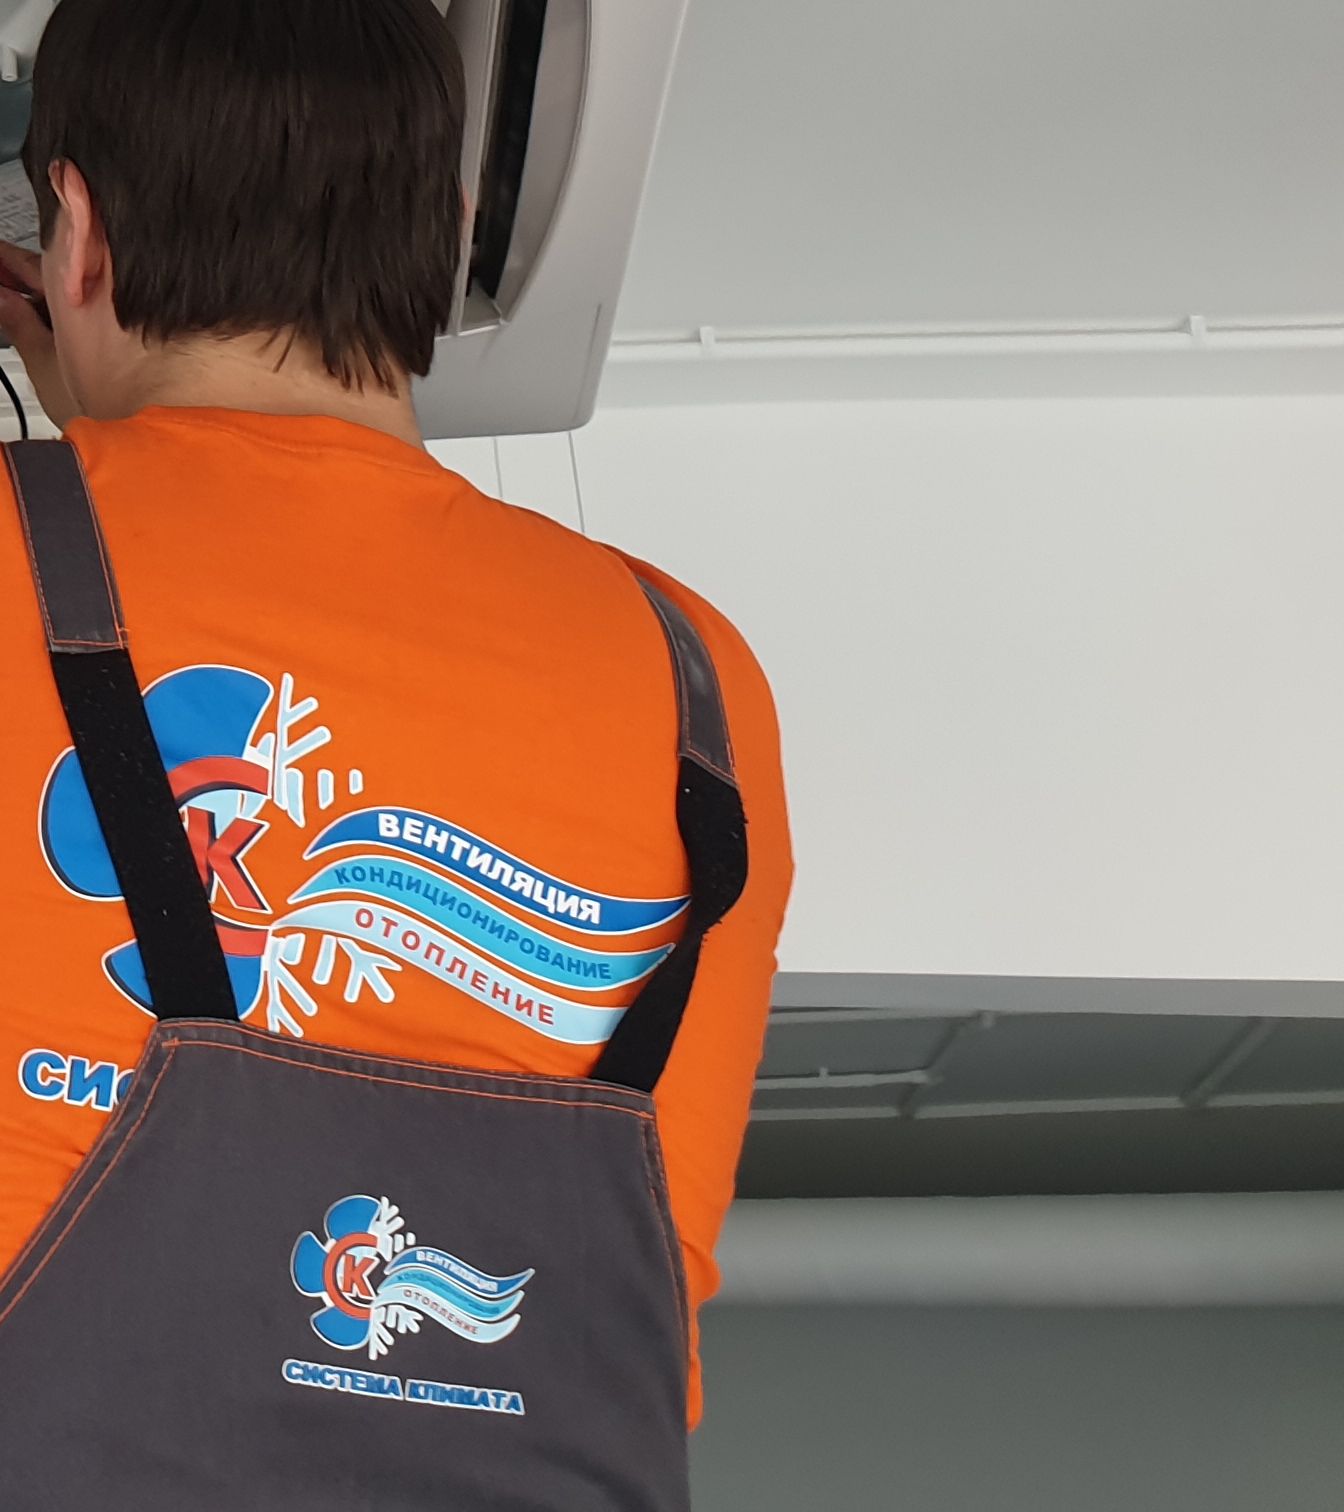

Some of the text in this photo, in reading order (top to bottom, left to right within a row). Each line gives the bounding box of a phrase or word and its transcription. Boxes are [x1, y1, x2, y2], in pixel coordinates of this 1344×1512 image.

[334, 865, 612, 980] КОНДИЦИОНИРОВАНИЕ
[377, 812, 602, 925] ВЕНТИЛЯЦИЯ
[355, 908, 555, 1025] ОТОПЛЕНИЕ
[18, 1049, 134, 1112] СИ
[283, 1359, 524, 1414] СИСТЕМА КЛИМАТА
